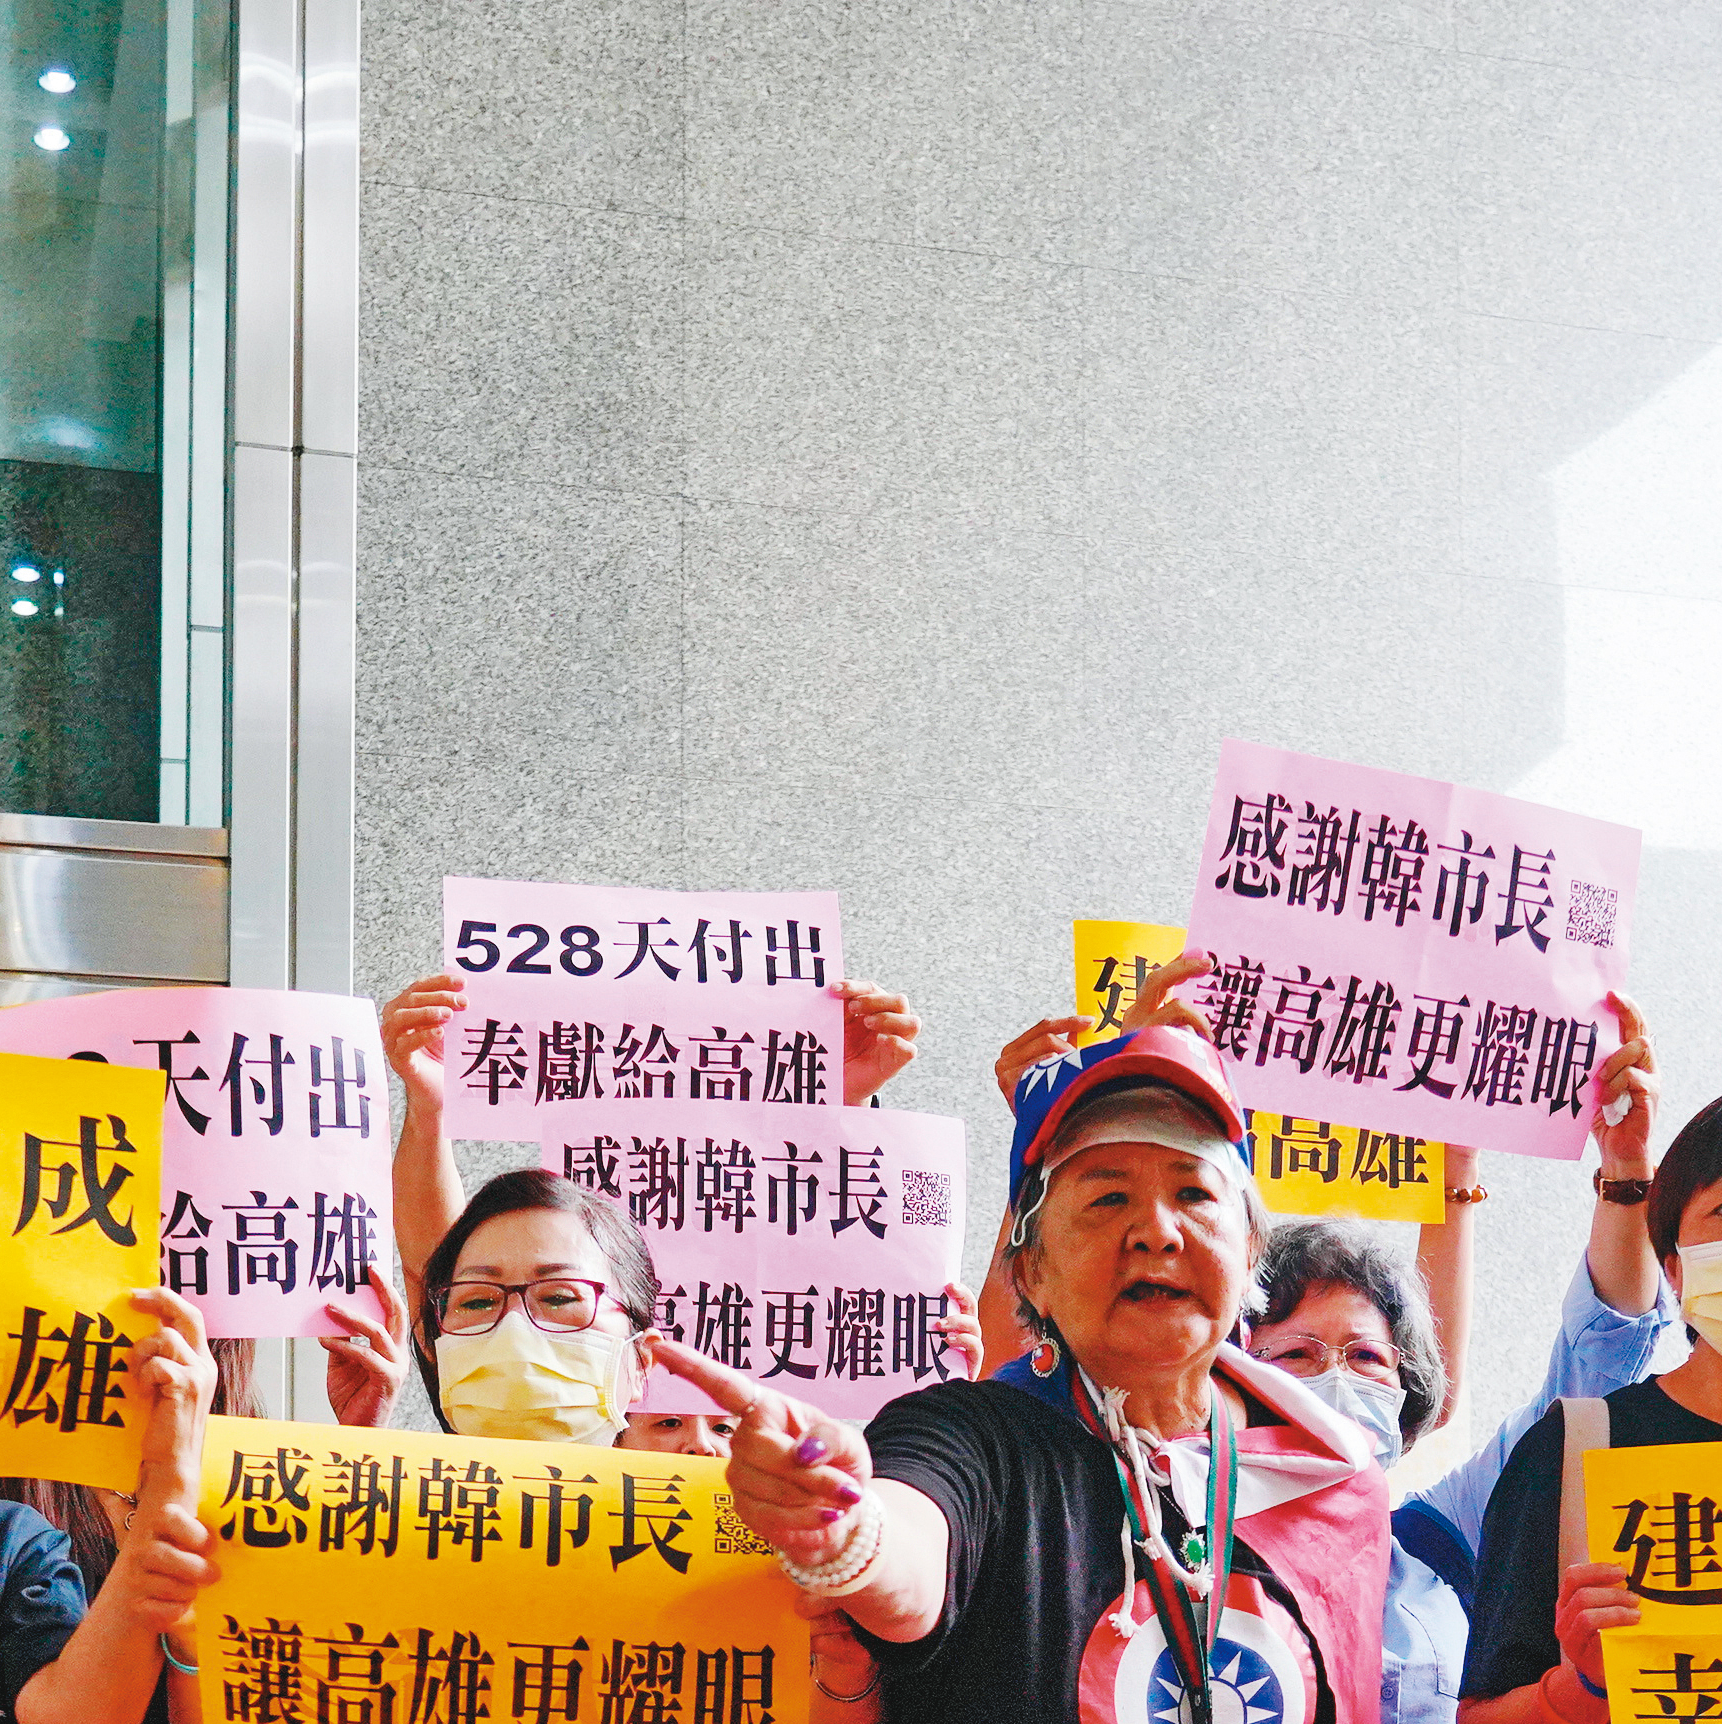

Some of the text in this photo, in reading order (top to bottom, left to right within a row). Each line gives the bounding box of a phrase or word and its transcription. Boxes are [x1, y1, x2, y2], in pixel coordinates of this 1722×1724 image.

[1214, 793, 1555, 954] 感謝韓市長
[455, 917, 827, 988] 528天付出
[67, 1030, 371, 1141] 天付出
[459, 1018, 829, 1107] 奉獻給高雄
[1193, 949, 1599, 1118] 讓高雄更耀眼
[563, 1135, 889, 1240] 感謝韓市長
[219, 1447, 694, 1575] 感謝韓市長
